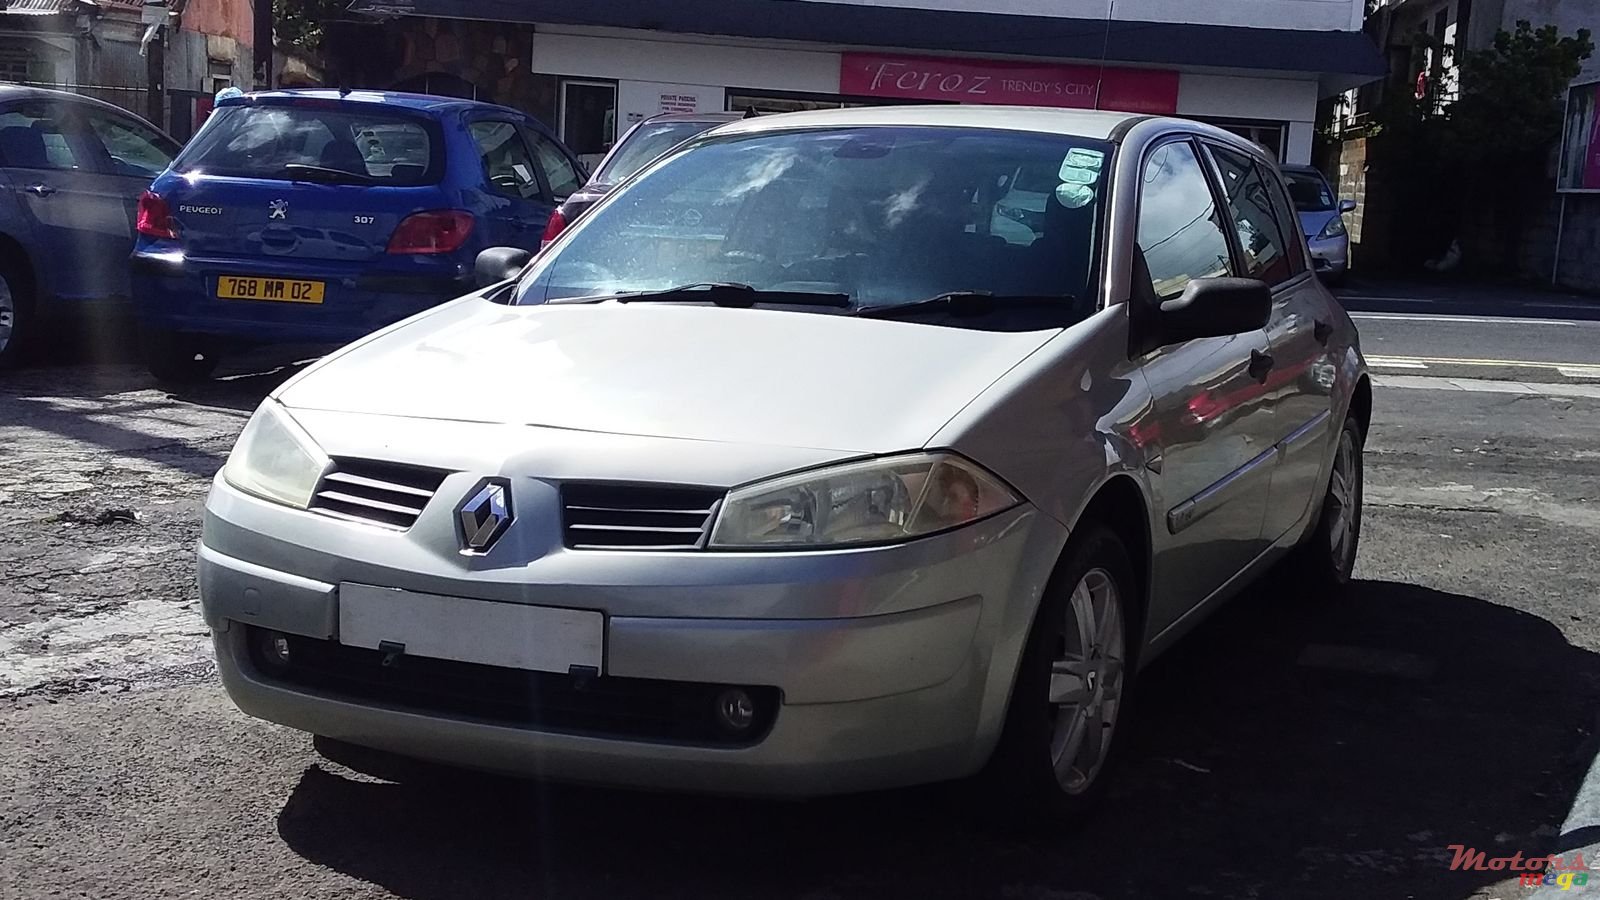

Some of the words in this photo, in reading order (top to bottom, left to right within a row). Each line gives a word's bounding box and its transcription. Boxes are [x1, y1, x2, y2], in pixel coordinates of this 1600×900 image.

[865, 62, 992, 94] Feroz
[1001, 79, 1062, 95] TRENDY'S
[1065, 83, 1095, 96] CITY
[179, 205, 223, 215] PEUGEOT
[354, 215, 375, 225] 307
[228, 278, 258, 298] 768
[291, 282, 312, 300] 02
